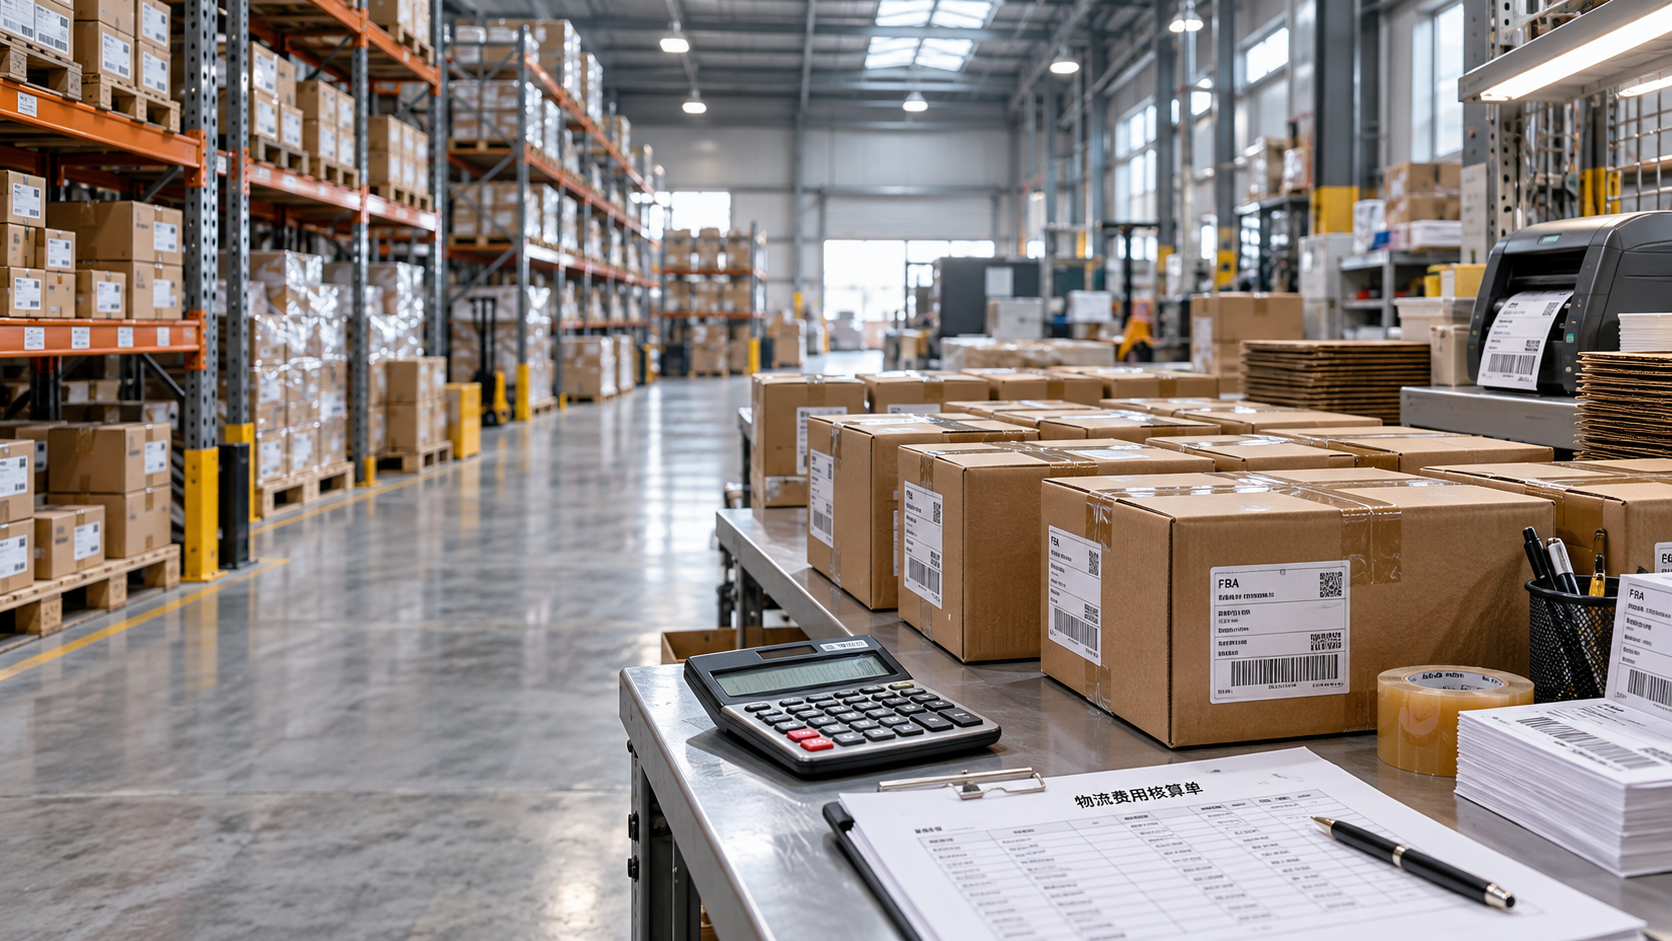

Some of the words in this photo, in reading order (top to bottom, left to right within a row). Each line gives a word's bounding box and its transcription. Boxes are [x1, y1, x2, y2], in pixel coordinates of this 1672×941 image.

[1218, 578, 1240, 589] FBA
[1074, 781, 1204, 809] 物流费用核算单
